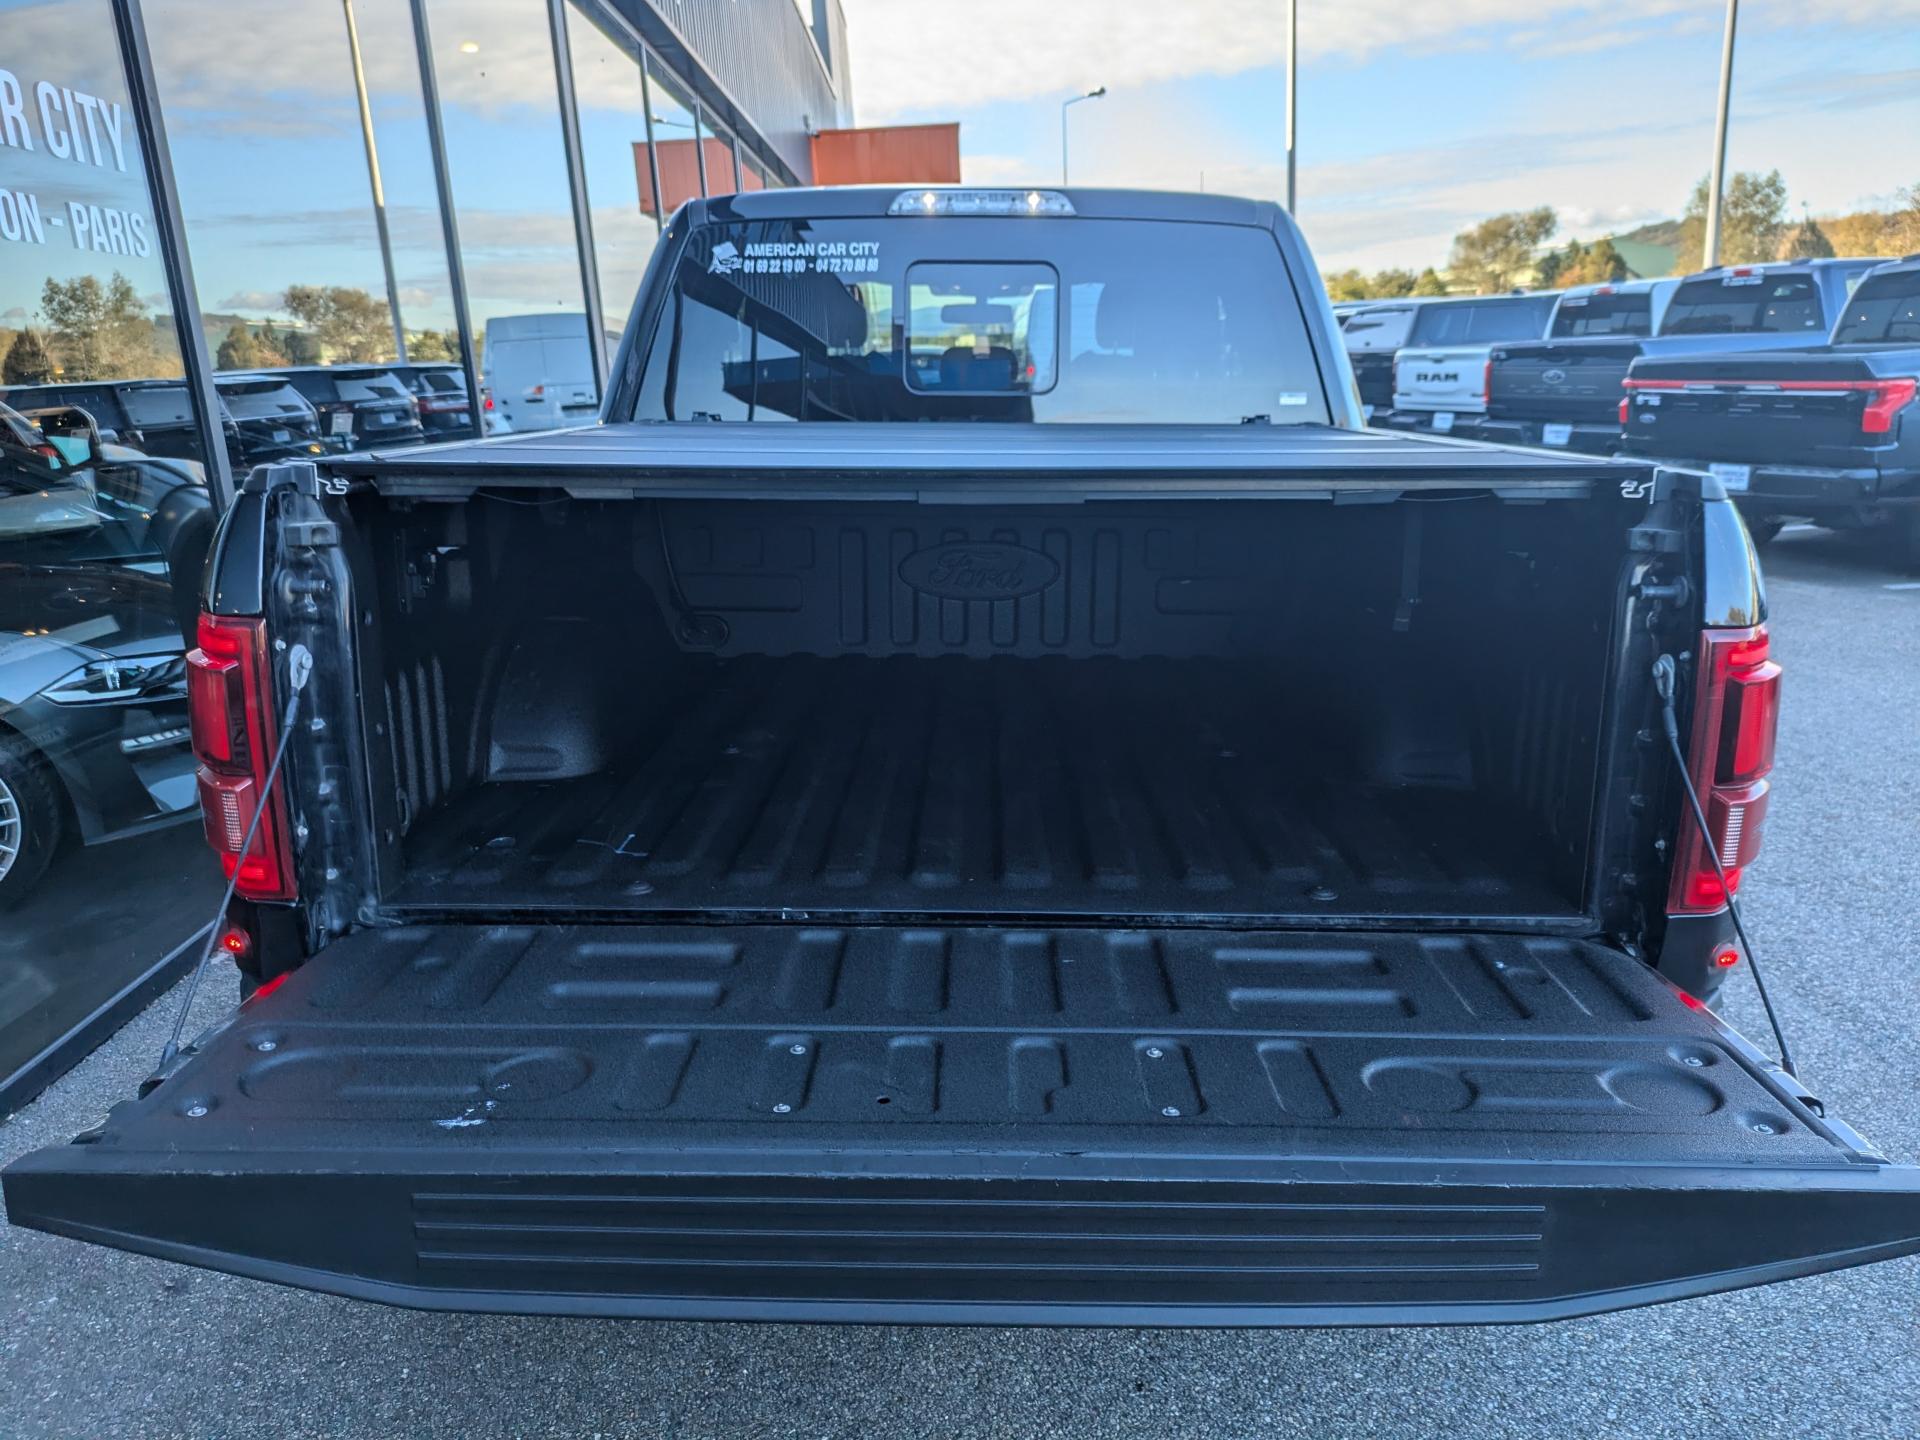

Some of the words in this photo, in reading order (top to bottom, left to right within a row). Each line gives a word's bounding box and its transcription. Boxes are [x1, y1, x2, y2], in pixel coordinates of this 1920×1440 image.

[0, 69, 34, 151] R
[36, 80, 127, 172] CITY
[68, 201, 150, 258] PARIS
[744, 243, 815, 257] AMERICAN
[817, 242, 847, 256] CAR
[849, 242, 880, 256] CITY
[743, 258, 754, 274] 01
[769, 258, 781, 274] 22
[816, 258, 828, 273] 04
[830, 258, 841, 273] 72
[842, 258, 854, 273] 70
[1416, 373, 1459, 382] RAM
[928, 551, 1025, 588] Ford
